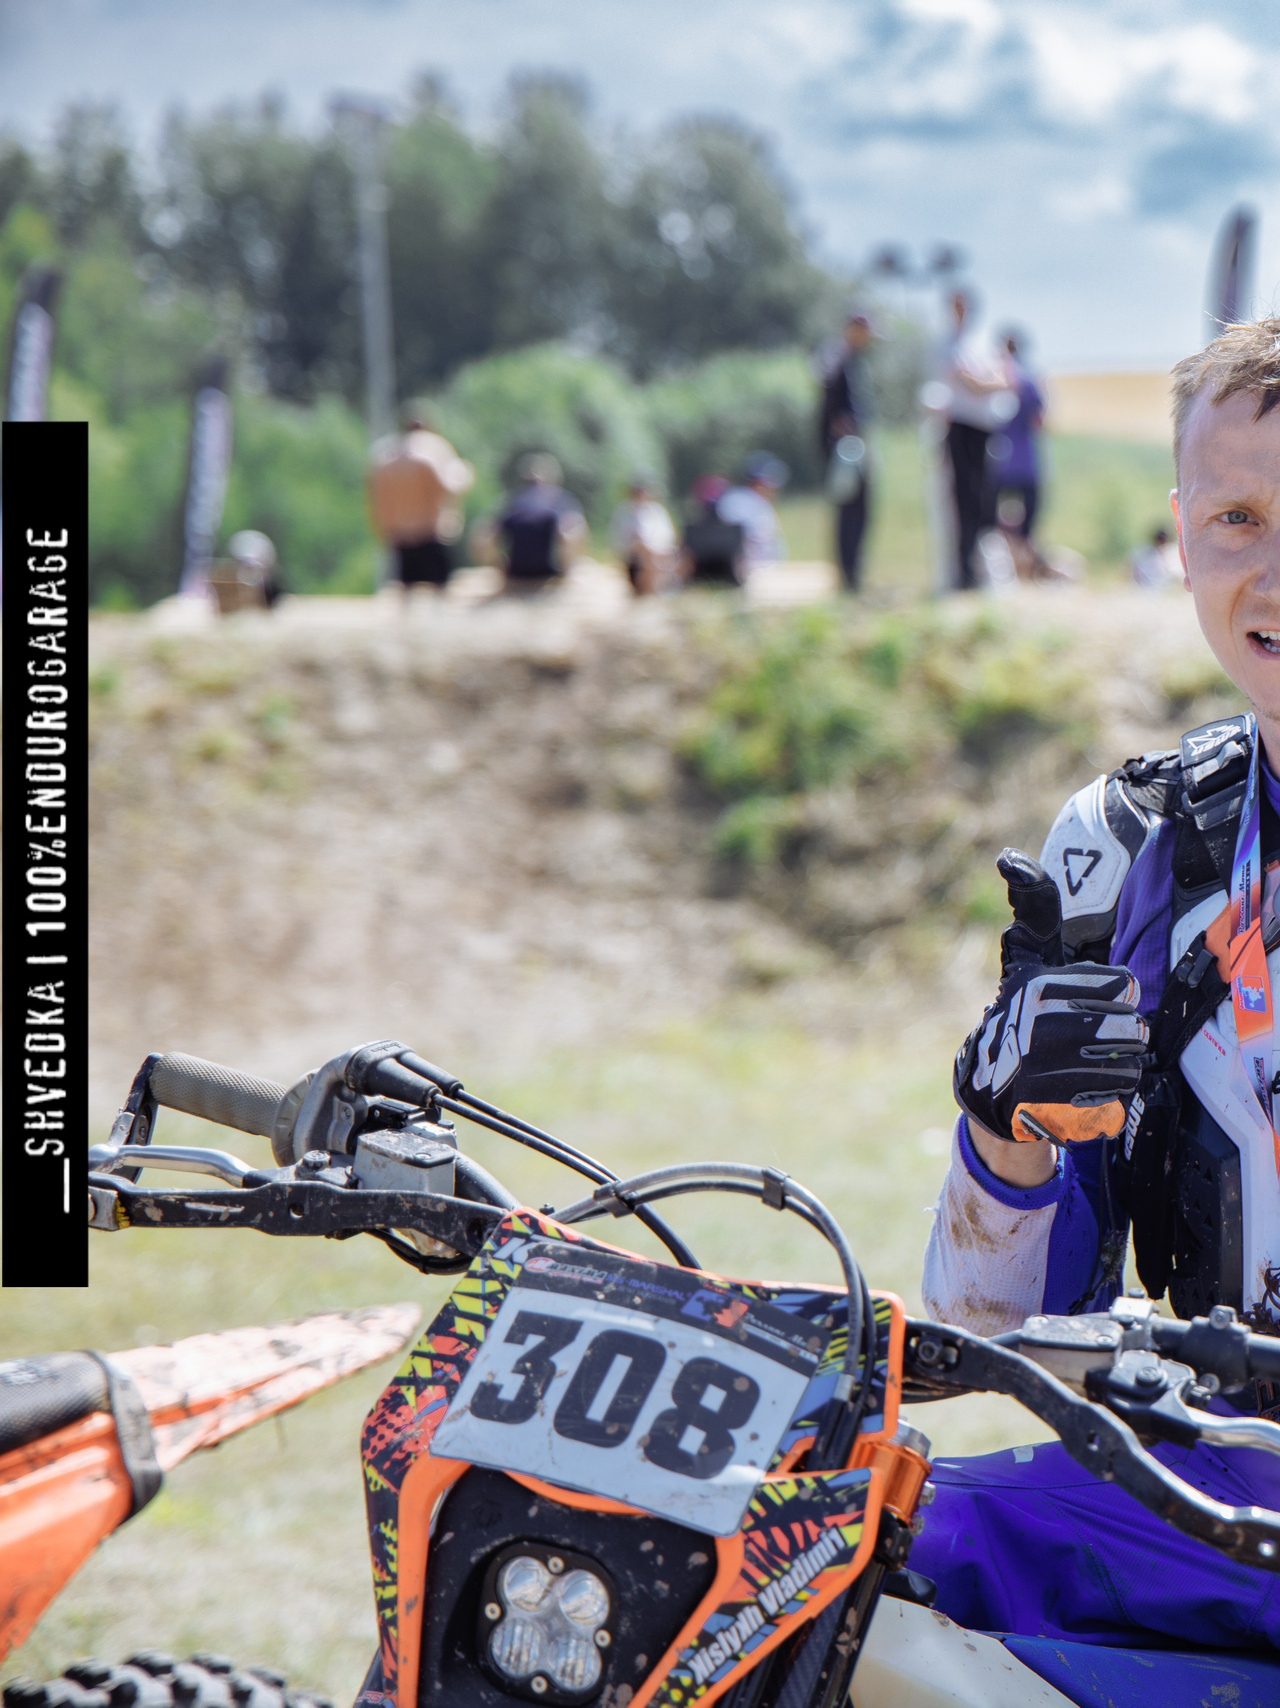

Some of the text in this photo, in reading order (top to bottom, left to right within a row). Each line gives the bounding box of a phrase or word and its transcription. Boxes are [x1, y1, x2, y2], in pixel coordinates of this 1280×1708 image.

[469, 1309, 761, 1480] 308
[687, 1527, 846, 1686] Kislykh Vladimir
